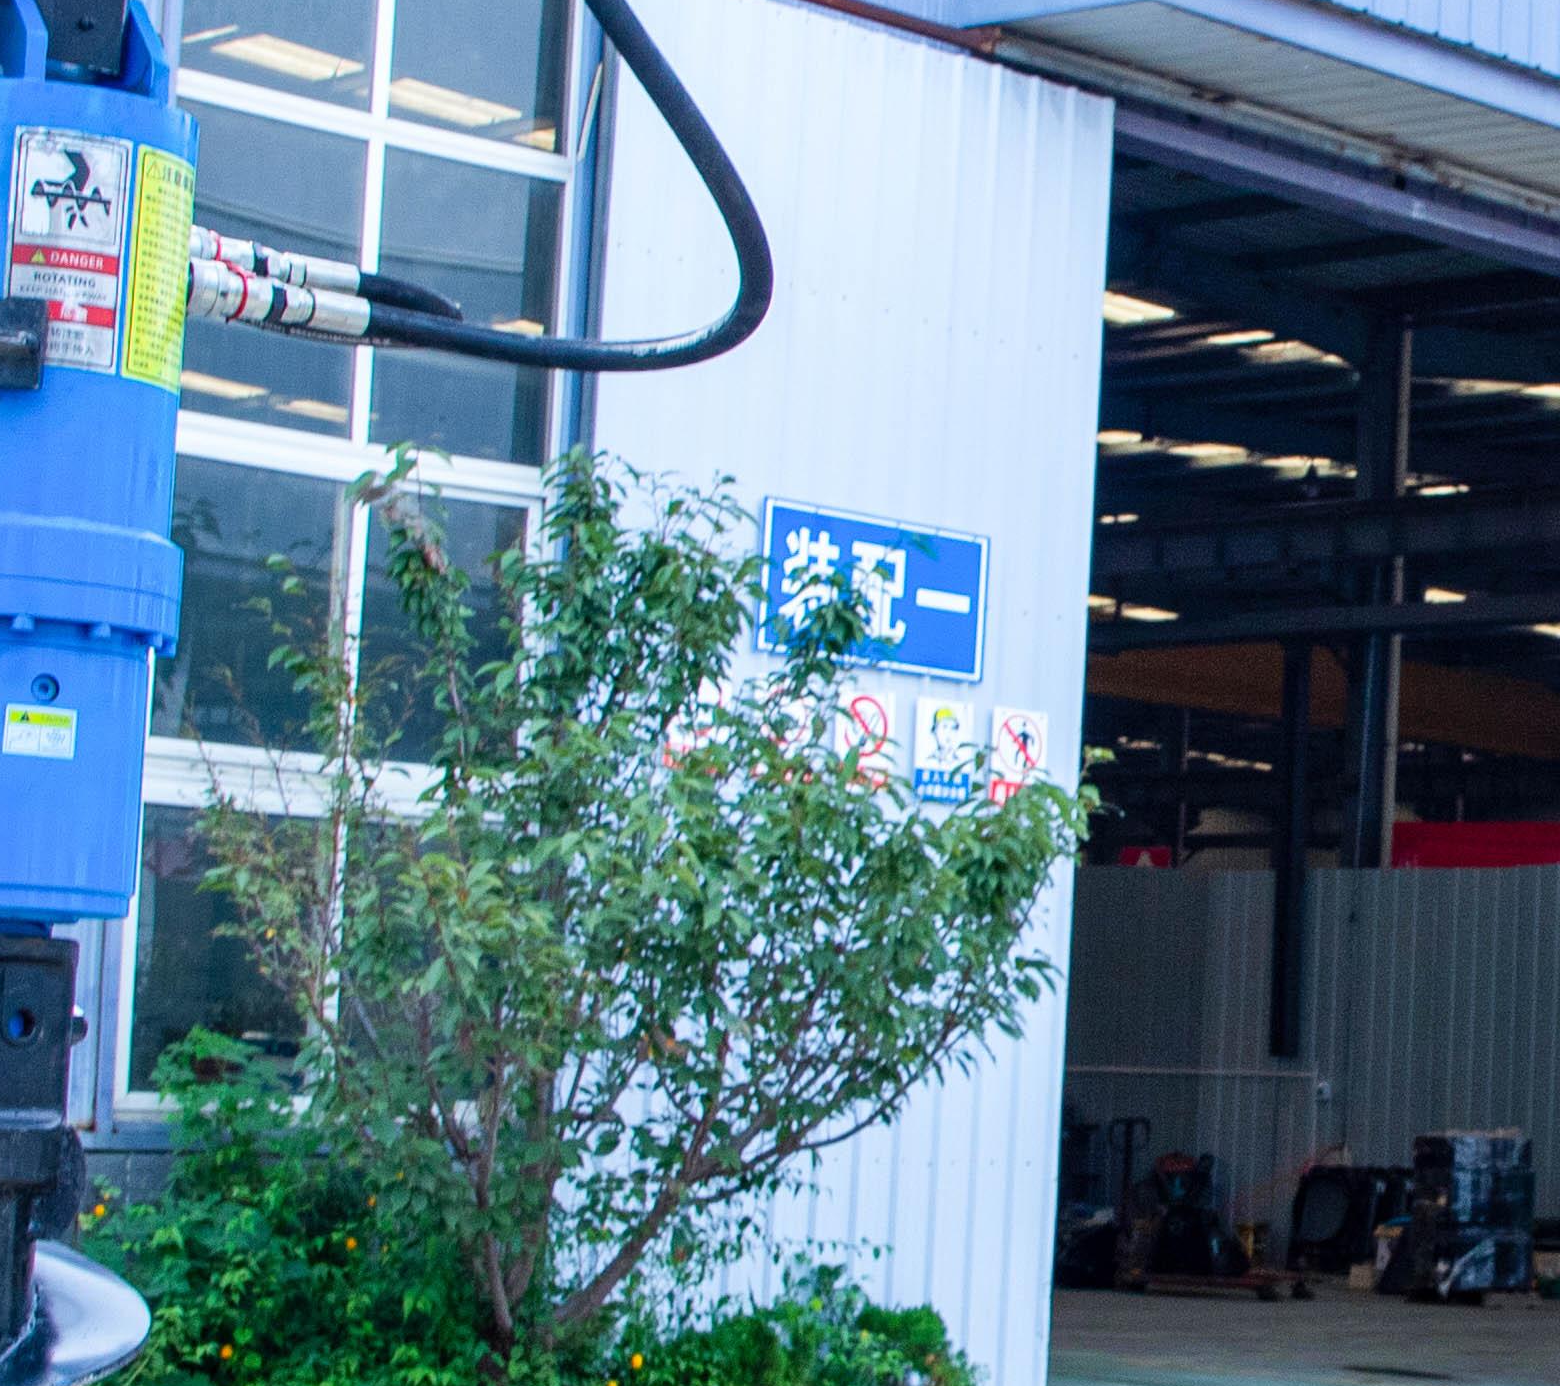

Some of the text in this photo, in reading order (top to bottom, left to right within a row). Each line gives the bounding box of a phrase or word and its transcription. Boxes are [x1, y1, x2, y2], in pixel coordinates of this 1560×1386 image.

[50, 251, 104, 270] DANGER
[33, 271, 96, 288] ROTATING
[778, 526, 972, 644] 装配一
